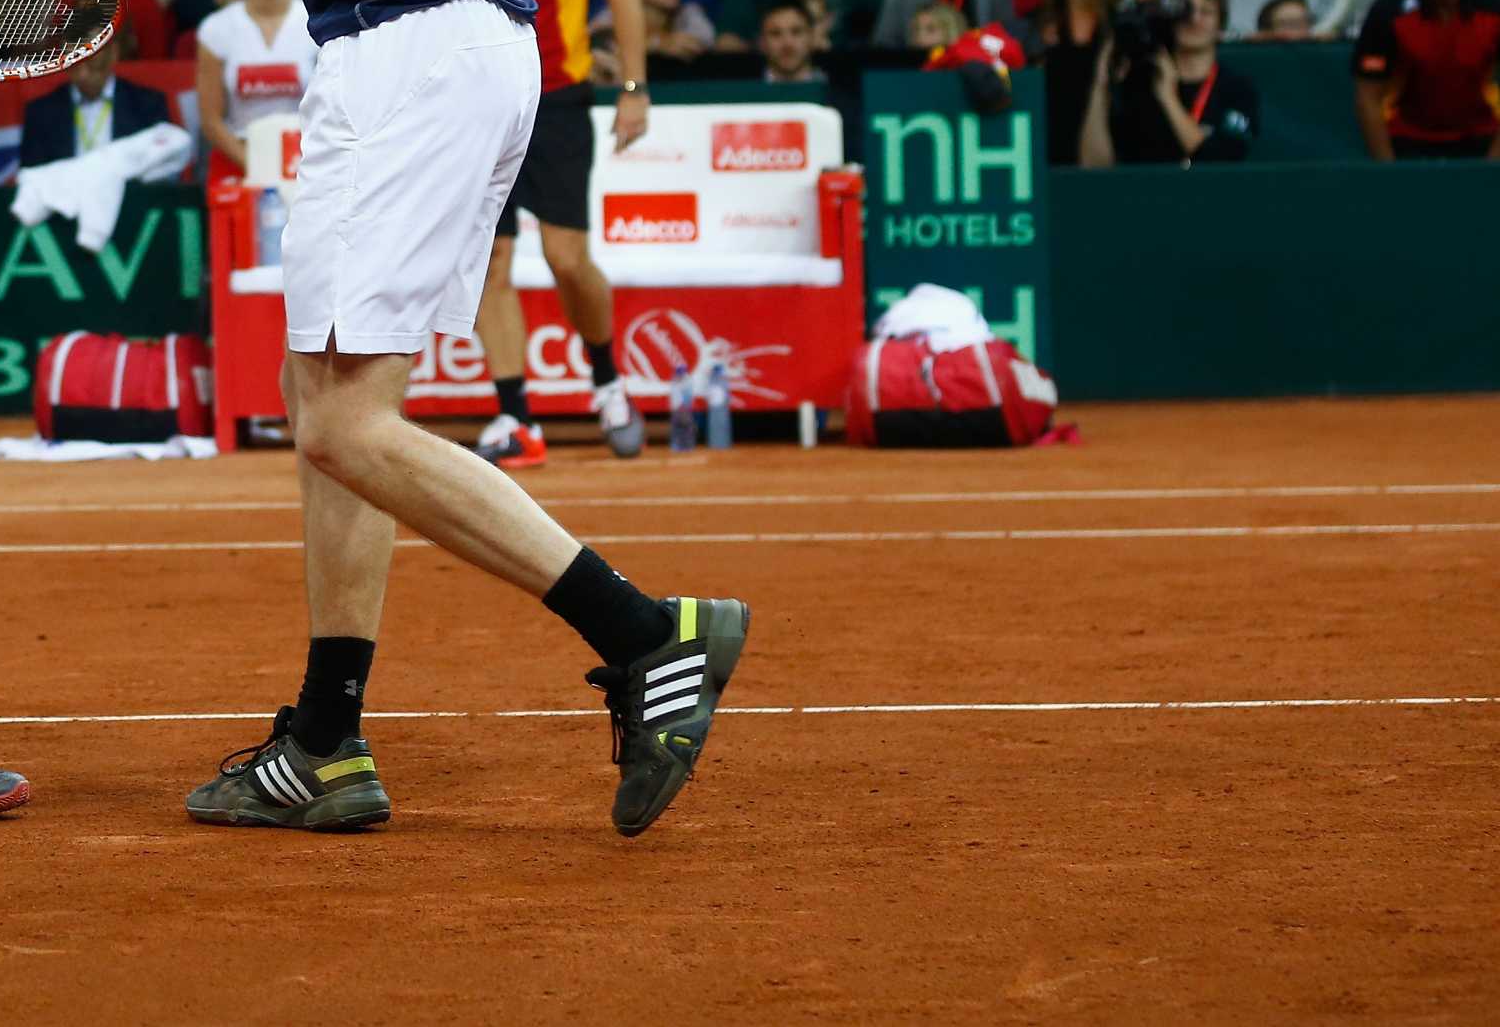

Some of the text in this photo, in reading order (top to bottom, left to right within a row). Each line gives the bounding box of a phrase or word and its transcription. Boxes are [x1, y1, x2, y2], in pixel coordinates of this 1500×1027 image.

[718, 146, 804, 167] Adecco
[609, 215, 697, 239] Adecco
[883, 213, 1035, 247] HOTELS
